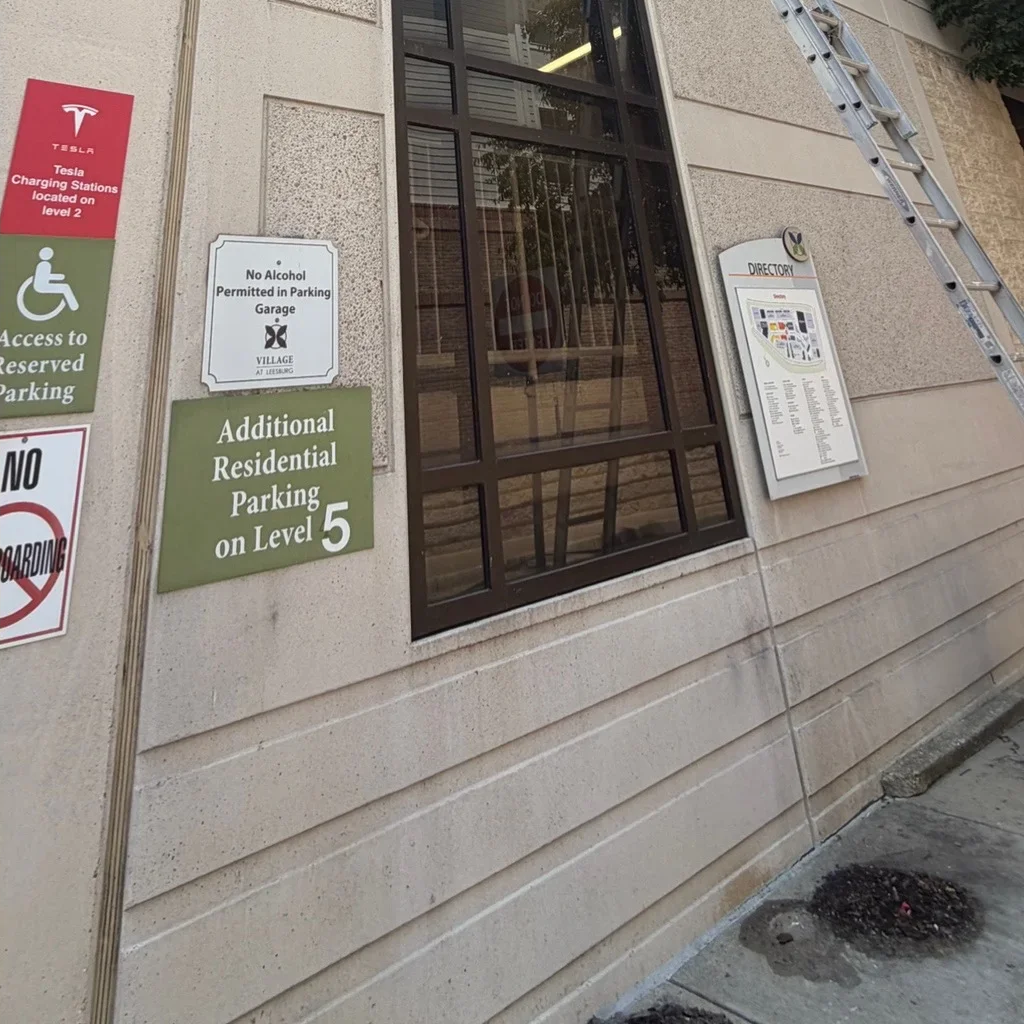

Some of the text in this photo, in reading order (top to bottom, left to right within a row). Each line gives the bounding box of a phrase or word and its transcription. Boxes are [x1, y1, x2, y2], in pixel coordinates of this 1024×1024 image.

[52, 143, 94, 154] TESLA
[53, 164, 85, 177] Tesla
[11, 174, 119, 194] Charging Stations
[32, 190, 95, 206] located on
[42, 205, 82, 219] level 2
[245, 269, 306, 281] No Alcohol
[748, 262, 794, 276] DIRECTORY
[216, 285, 331, 300] Permitted in Parking
[255, 303, 296, 317] Garage
[0, 329, 88, 348] Access to
[256, 355, 294, 365] VILLAGE
[216, 408, 335, 445] Additional
[1, 447, 43, 492] NO
[211, 441, 337, 482] Residential
[230, 483, 320, 517] Parking
[214, 501, 351, 559] on Level 5
[0, 536, 67, 583] OARDING
